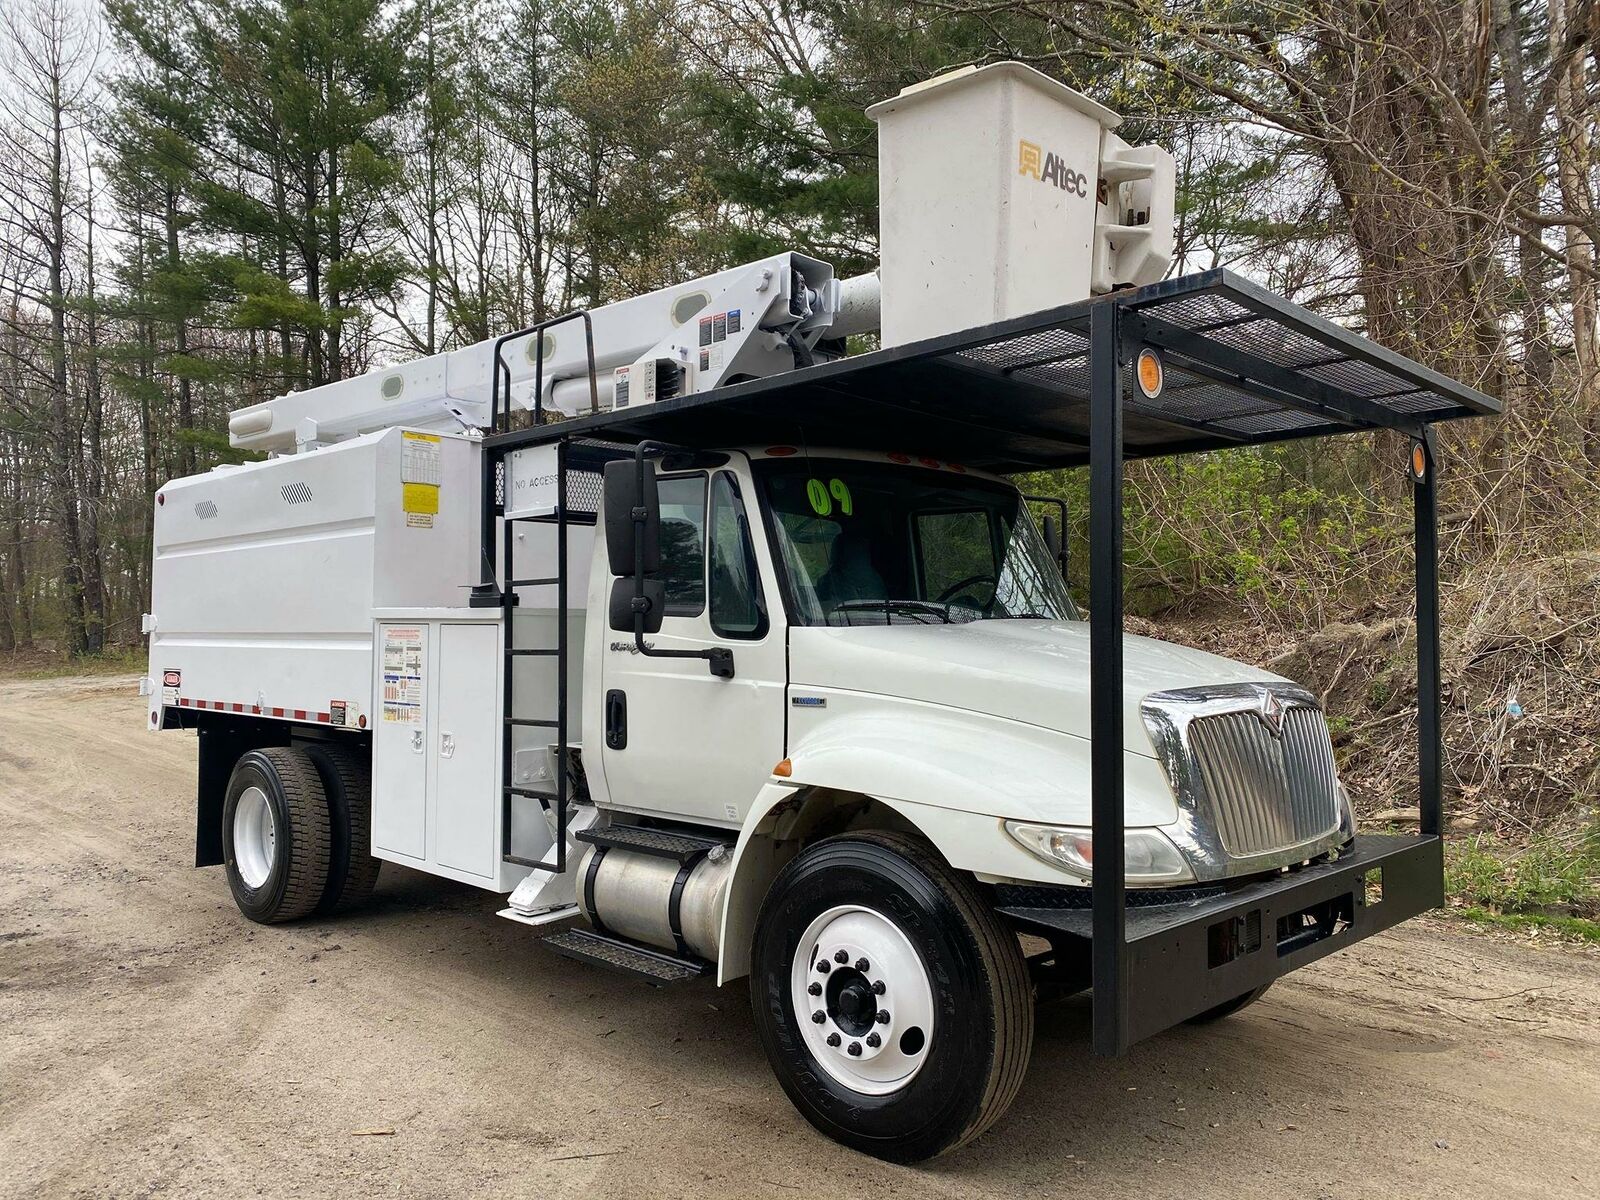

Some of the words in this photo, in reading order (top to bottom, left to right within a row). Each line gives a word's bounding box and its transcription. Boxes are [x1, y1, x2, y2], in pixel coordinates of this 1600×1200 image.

[1041, 152, 1087, 198] Altec
[515, 480, 526, 490] NO
[529, 474, 559, 488] ACCESS
[807, 479, 852, 516] 09
